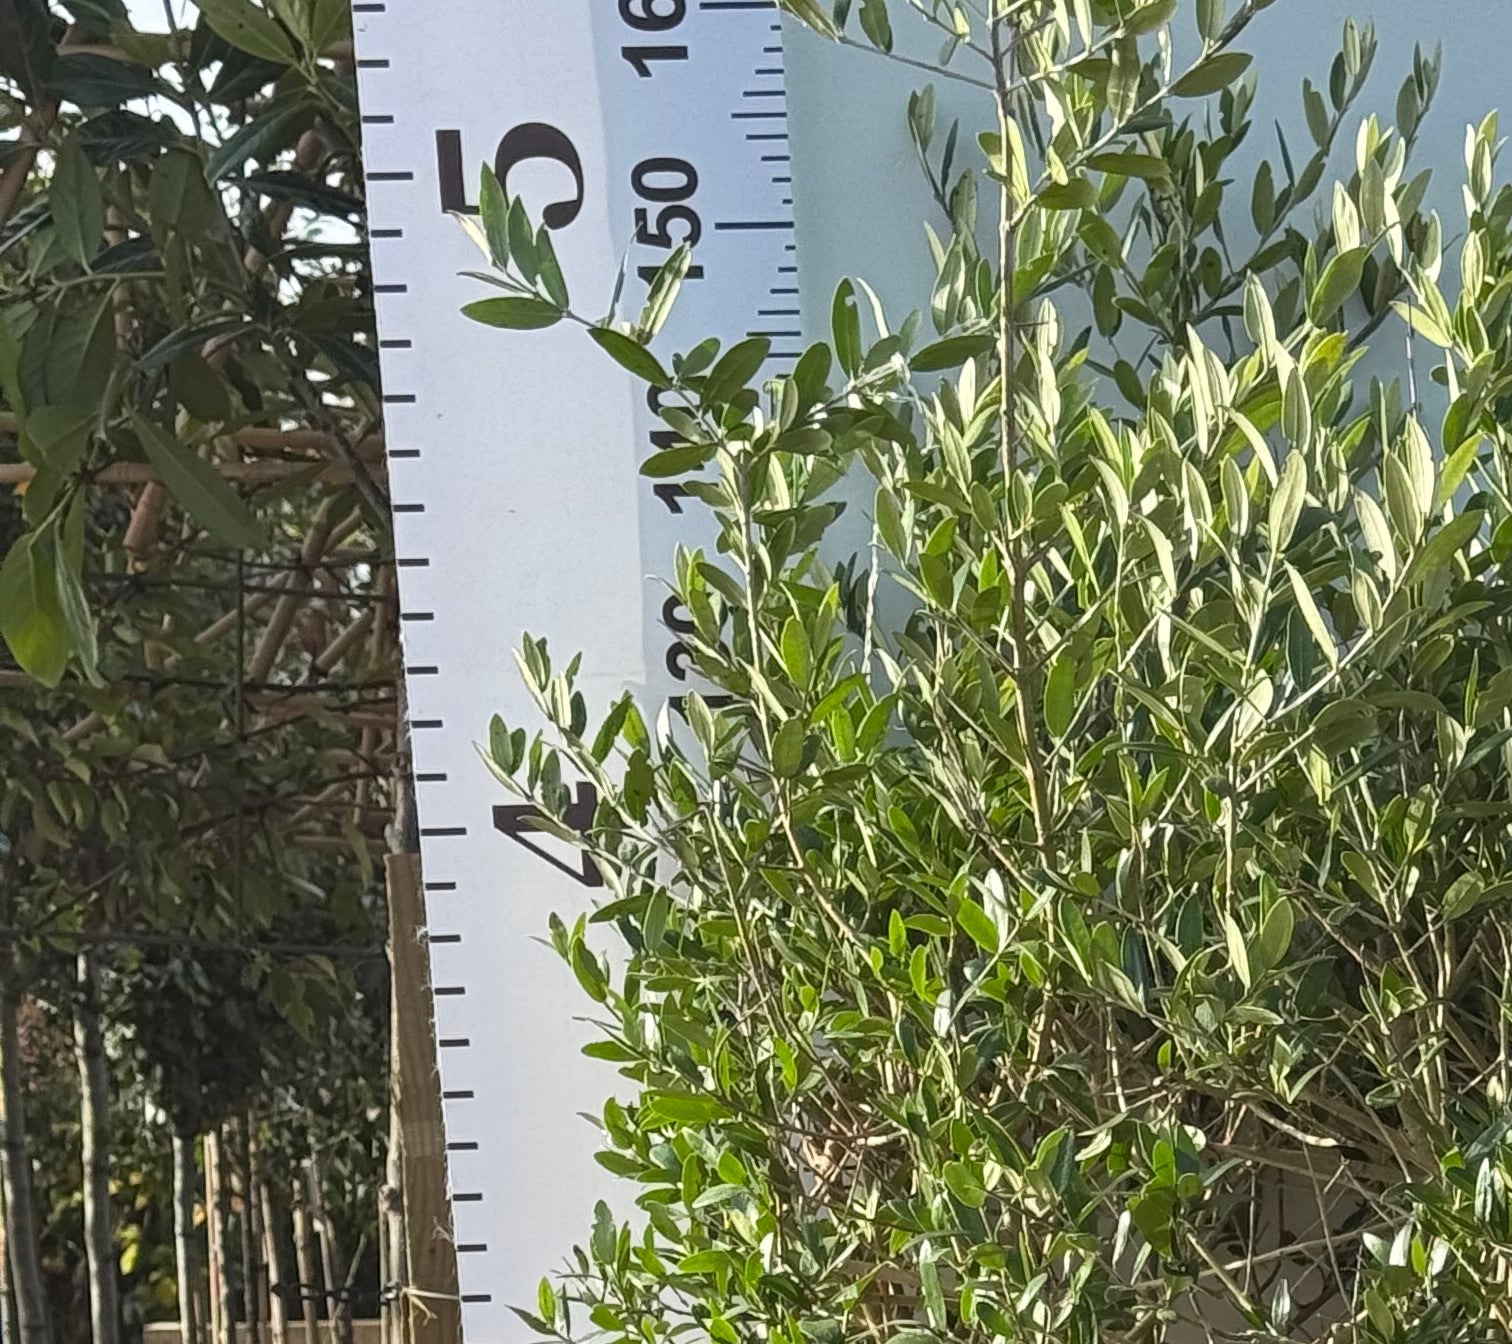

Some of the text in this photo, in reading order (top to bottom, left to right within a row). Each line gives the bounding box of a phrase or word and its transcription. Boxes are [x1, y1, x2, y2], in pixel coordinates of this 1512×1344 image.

[436, 122, 584, 230] 5
[631, 158, 704, 288] 150
[492, 781, 606, 887] 4
